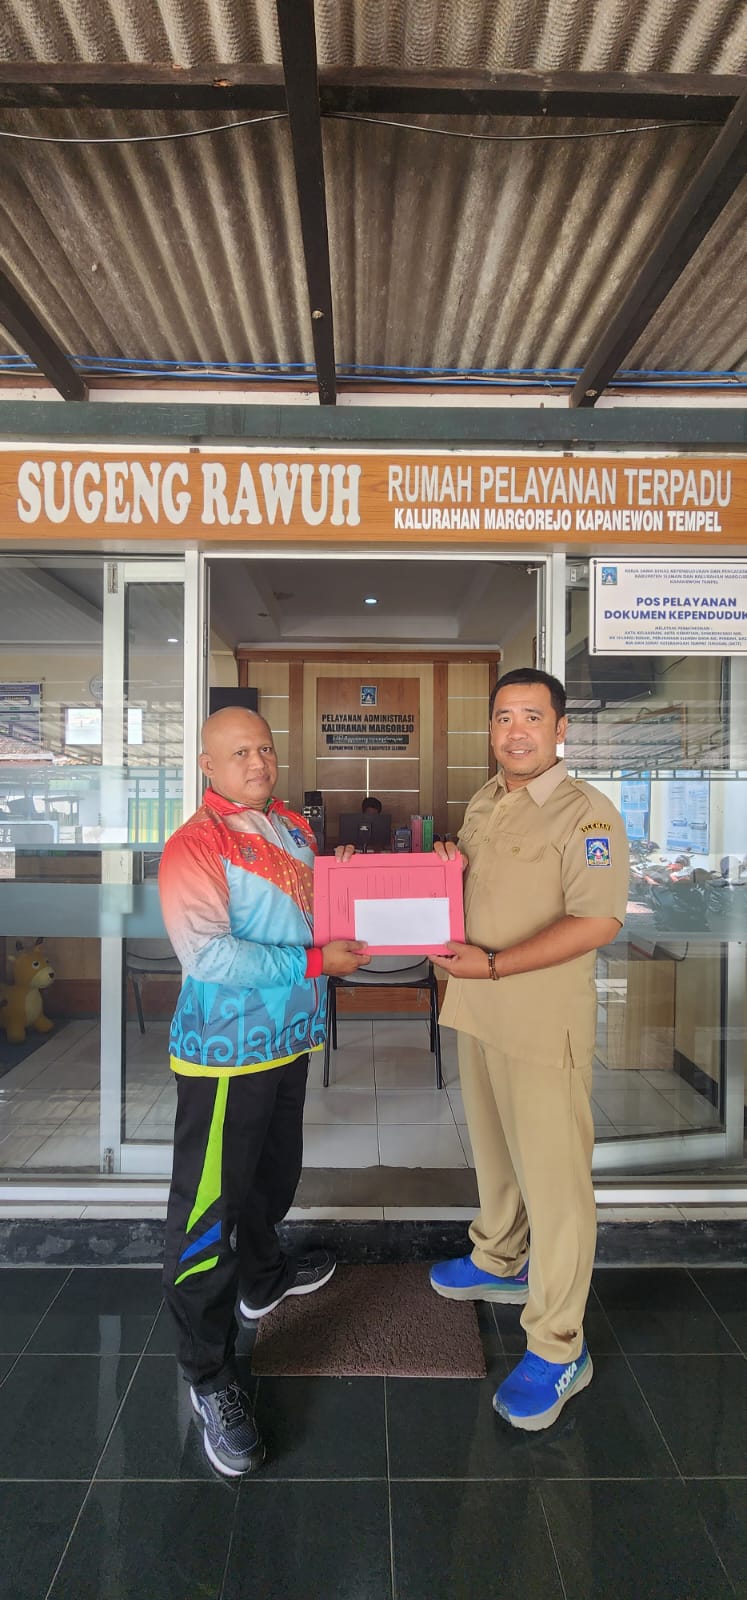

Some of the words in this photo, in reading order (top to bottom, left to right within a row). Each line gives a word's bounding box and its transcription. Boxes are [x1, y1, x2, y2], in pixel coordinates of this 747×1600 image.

[17, 460, 192, 524] SUGENG
[201, 462, 362, 526] RAWUH
[388, 465, 472, 503] RUMAH
[480, 466, 617, 505] PELAYANAN
[624, 468, 732, 507] TERPADU
[394, 508, 480, 529] KALURAHAN
[484, 509, 572, 531] MARGOREJO
[575, 509, 663, 532] KAPANEWON
[667, 511, 722, 533] TEMPEL
[636, 597, 660, 607] POS
[663, 597, 737, 607] PELAYANAN
[604, 610, 666, 620] DOKUMEN
[321, 714, 362, 723] PELAYANAN
[364, 714, 414, 723] ADMINISTRASI
[321, 724, 367, 733] KALURAHAN
[368, 724, 414, 733] MARGOREJO
[554, 1361, 578, 1398] HOKA
